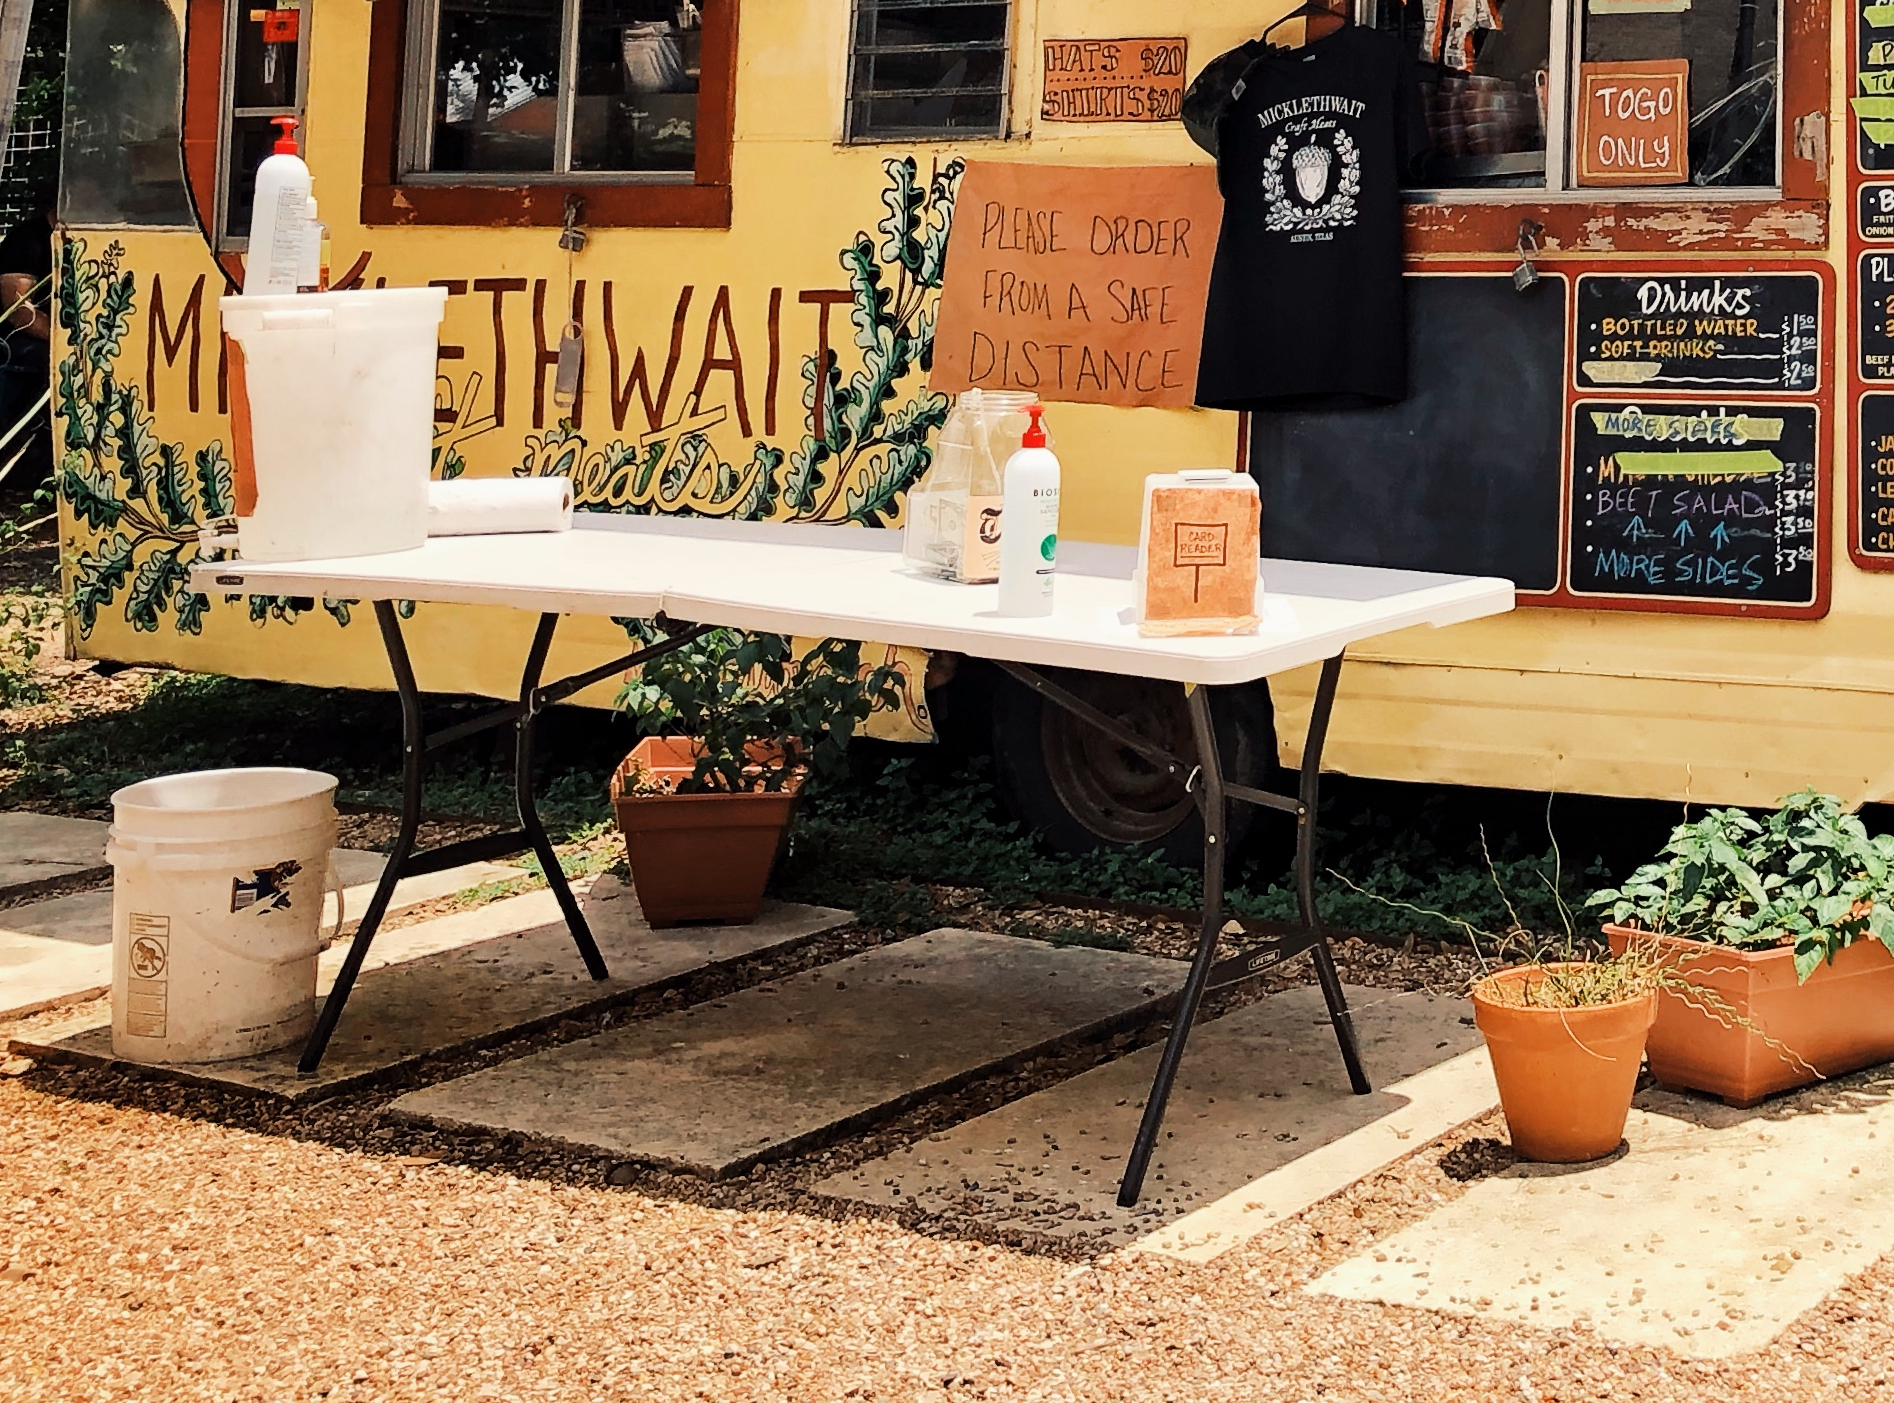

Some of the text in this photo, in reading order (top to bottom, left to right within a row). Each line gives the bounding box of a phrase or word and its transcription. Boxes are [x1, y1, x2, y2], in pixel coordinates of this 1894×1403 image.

[1046, 43, 1183, 76] HATS $20
[1042, 84, 1183, 119] SHIRTS $20
[1257, 94, 1366, 129] MICKLETHWAIT
[1594, 86, 1673, 123] TOGO
[1284, 115, 1337, 136] Craft Meats
[1598, 135, 1671, 169] ONLY
[981, 201, 1191, 258] PLEASE ORDER
[983, 269, 1178, 325] FROM A SAFE
[1636, 279, 1752, 316] Drinks
[1602, 317, 1758, 337] BOTTLED WATER
[146, 251, 856, 441] MIETHWAIT
[968, 331, 1184, 392] DISTANCE
[1600, 339, 1716, 359] SOFT DRINKS
[1865, 355, 1890, 365] BEEF
[1604, 414, 1655, 437] MORE
[1033, 488, 1058, 497] BIOS
[1596, 487, 1768, 519] BEET SALAD
[1180, 543, 1222, 554] READER
[1188, 531, 1215, 543] CARD
[1594, 547, 1764, 590] MORE SIDES
